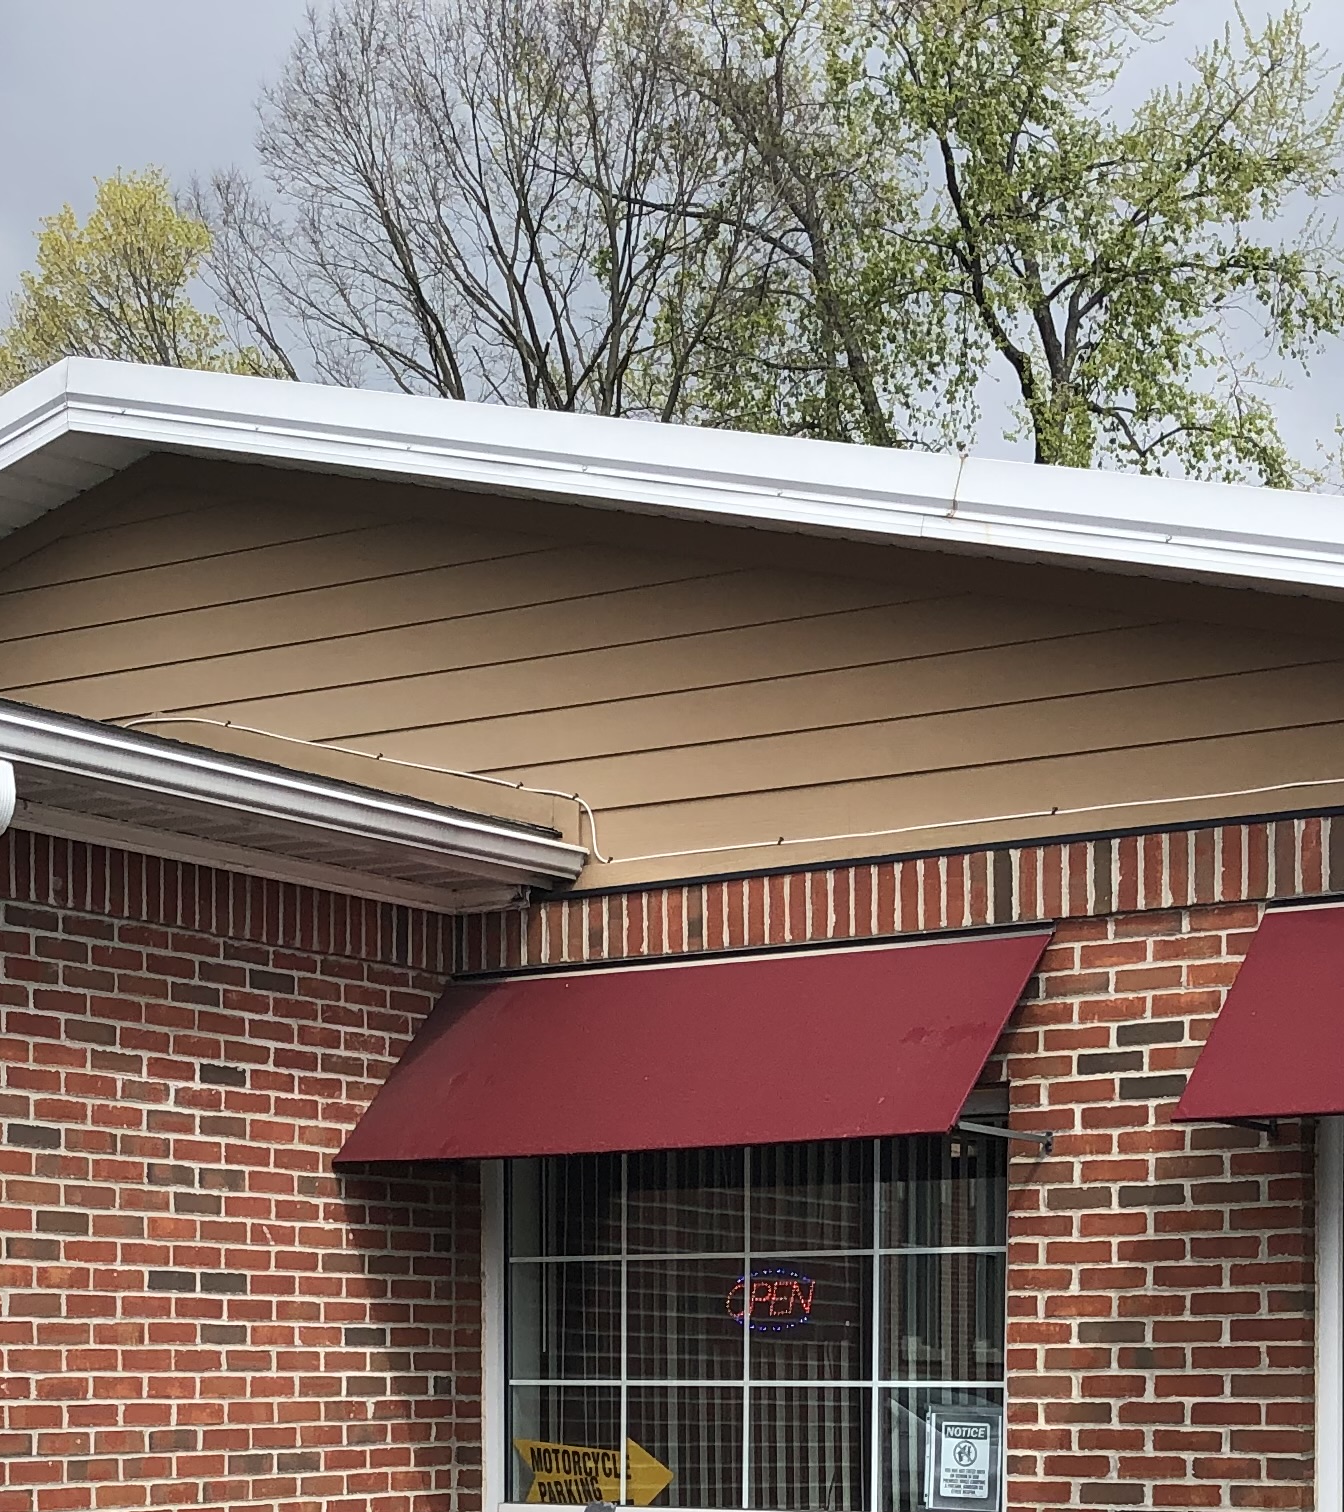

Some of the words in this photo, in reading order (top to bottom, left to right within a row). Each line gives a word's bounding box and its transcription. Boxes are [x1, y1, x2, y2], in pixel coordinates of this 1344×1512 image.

[725, 1280, 816, 1317] OPEN
[946, 1426, 986, 1438] NOTICE
[530, 1447, 632, 1479] MOTORCYCLE
[538, 1476, 603, 1502] PARKING
